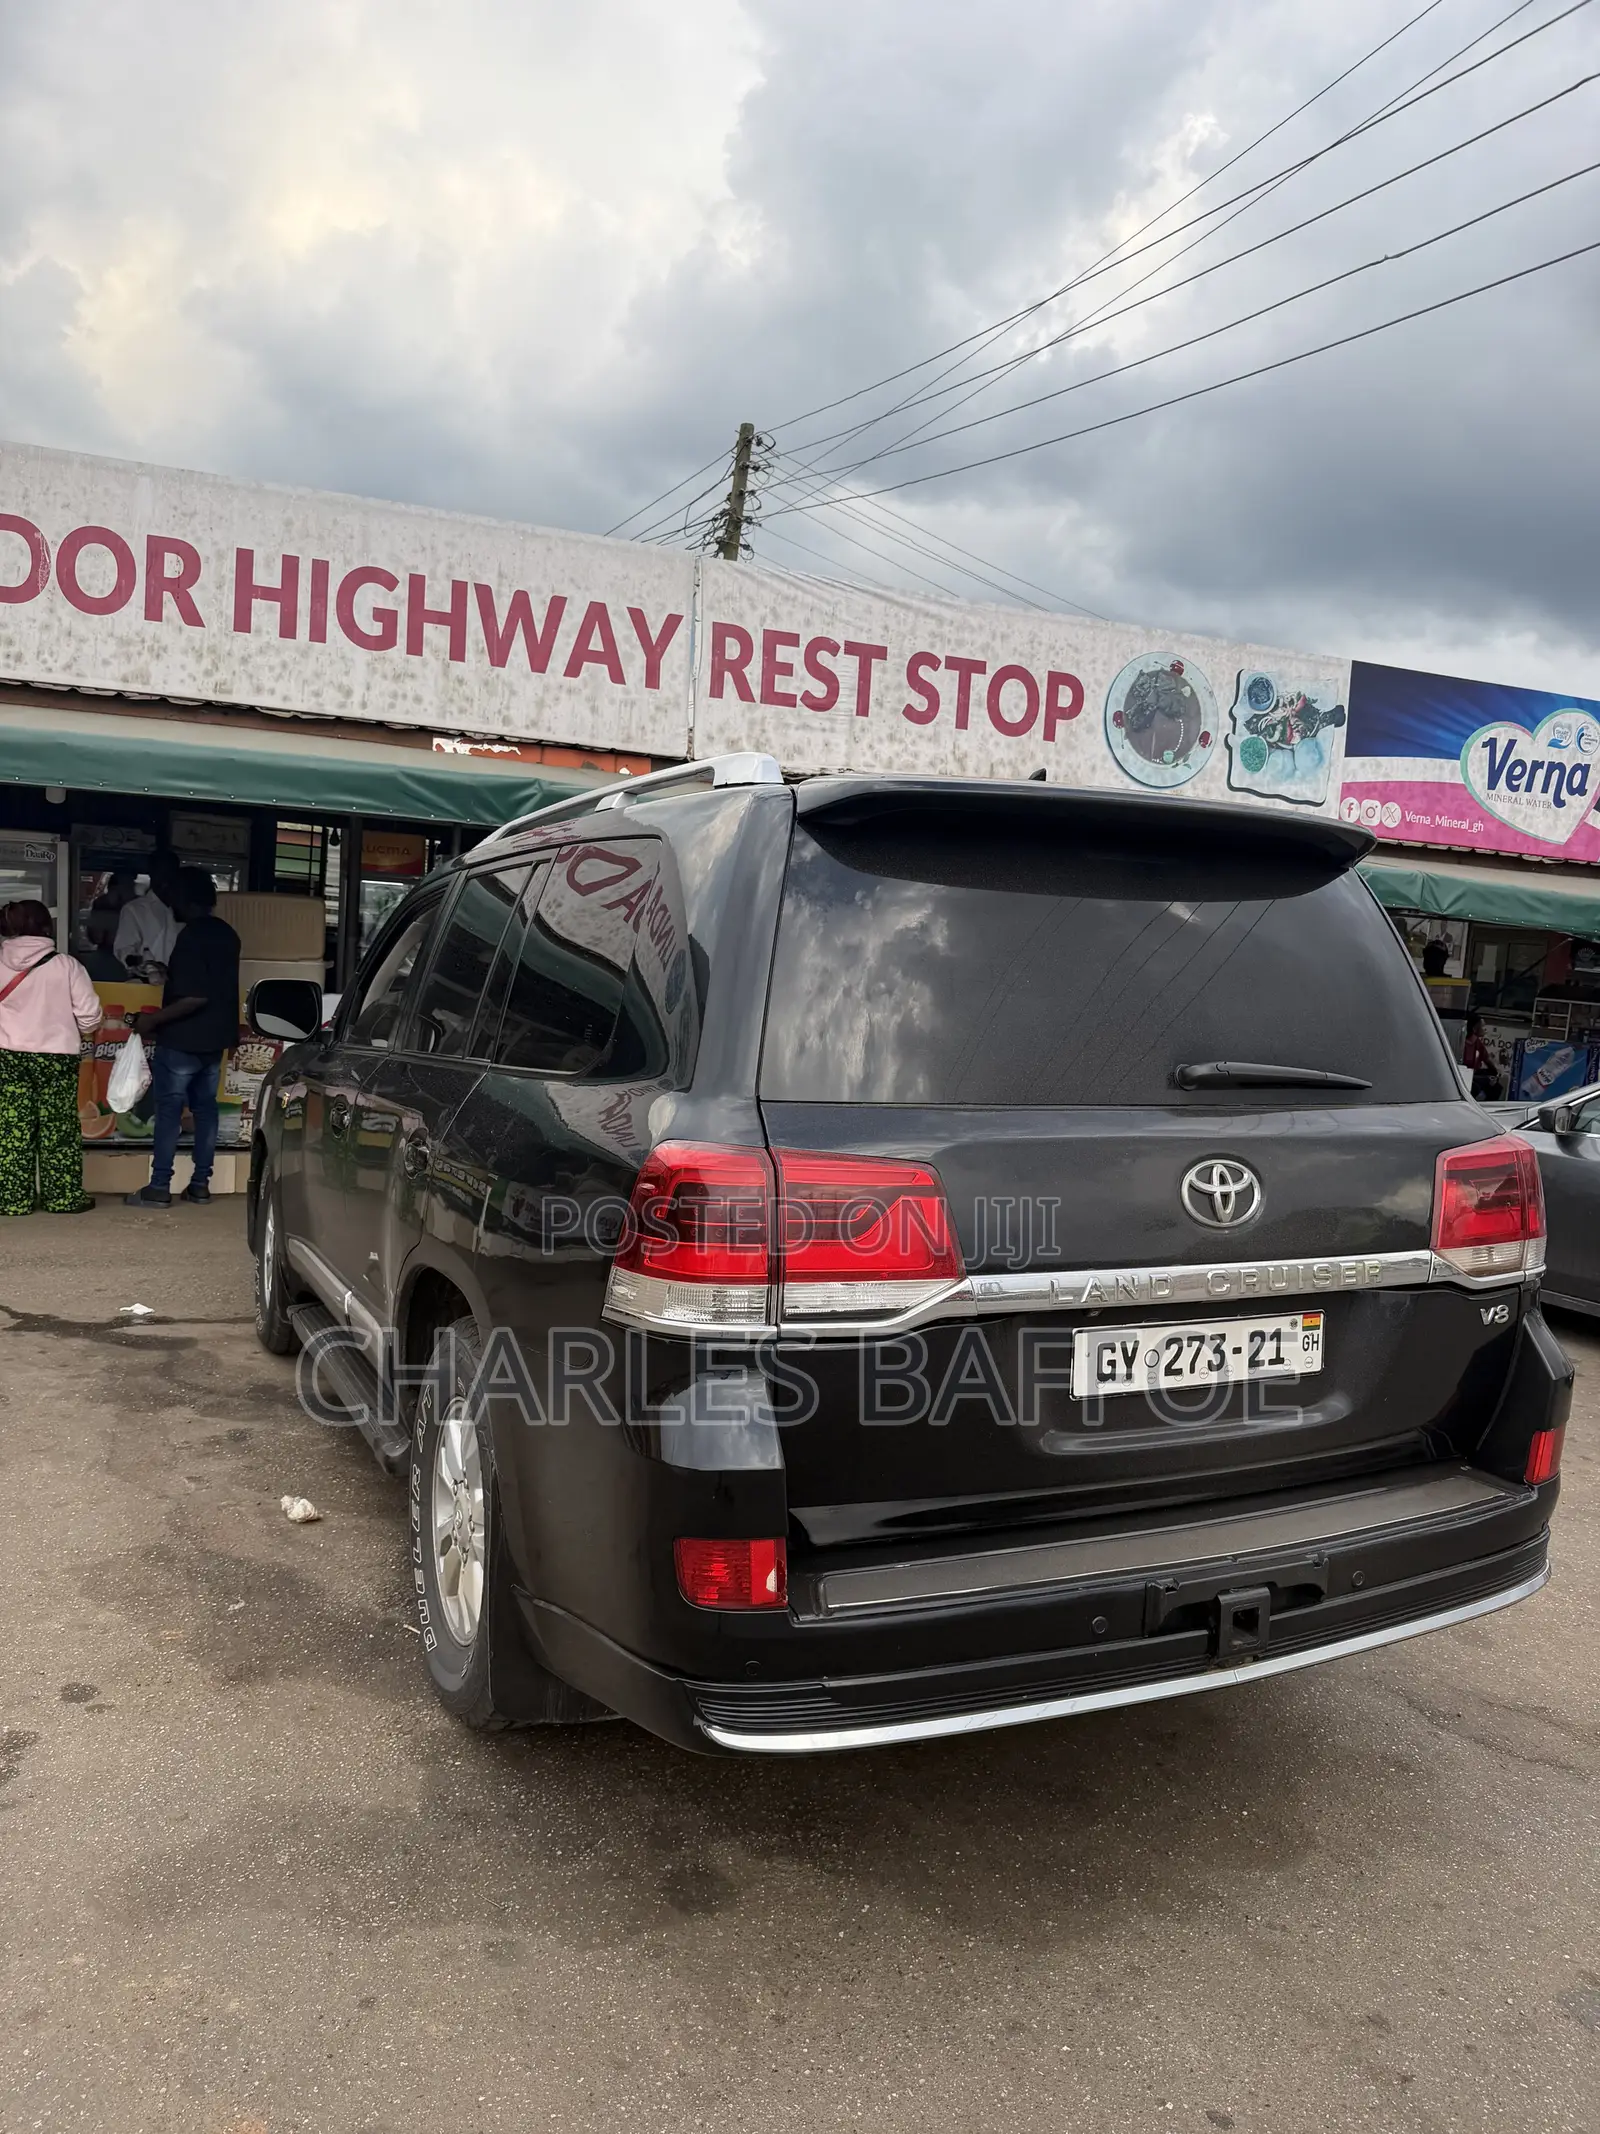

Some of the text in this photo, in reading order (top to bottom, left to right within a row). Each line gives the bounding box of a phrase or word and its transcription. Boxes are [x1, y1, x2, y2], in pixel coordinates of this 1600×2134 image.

[232, 547, 684, 690] HIGHWAY
[709, 621, 888, 718] REST
[902, 651, 1085, 743] STOP
[1481, 737, 1591, 809] Verna
[1486, 792, 1552, 810] MINERAL WATER
[1404, 810, 1484, 833] Verna_Mineral_gh
[238, 1043, 276, 1058] PIZZA
[1050, 1260, 1383, 1306] LAND CRUISER
[1479, 1304, 1510, 1326] V8
[1096, 1328, 1285, 1383] GY 273-21
[1302, 1334, 1320, 1353] GH
[411, 1463, 437, 1652] DUELER
